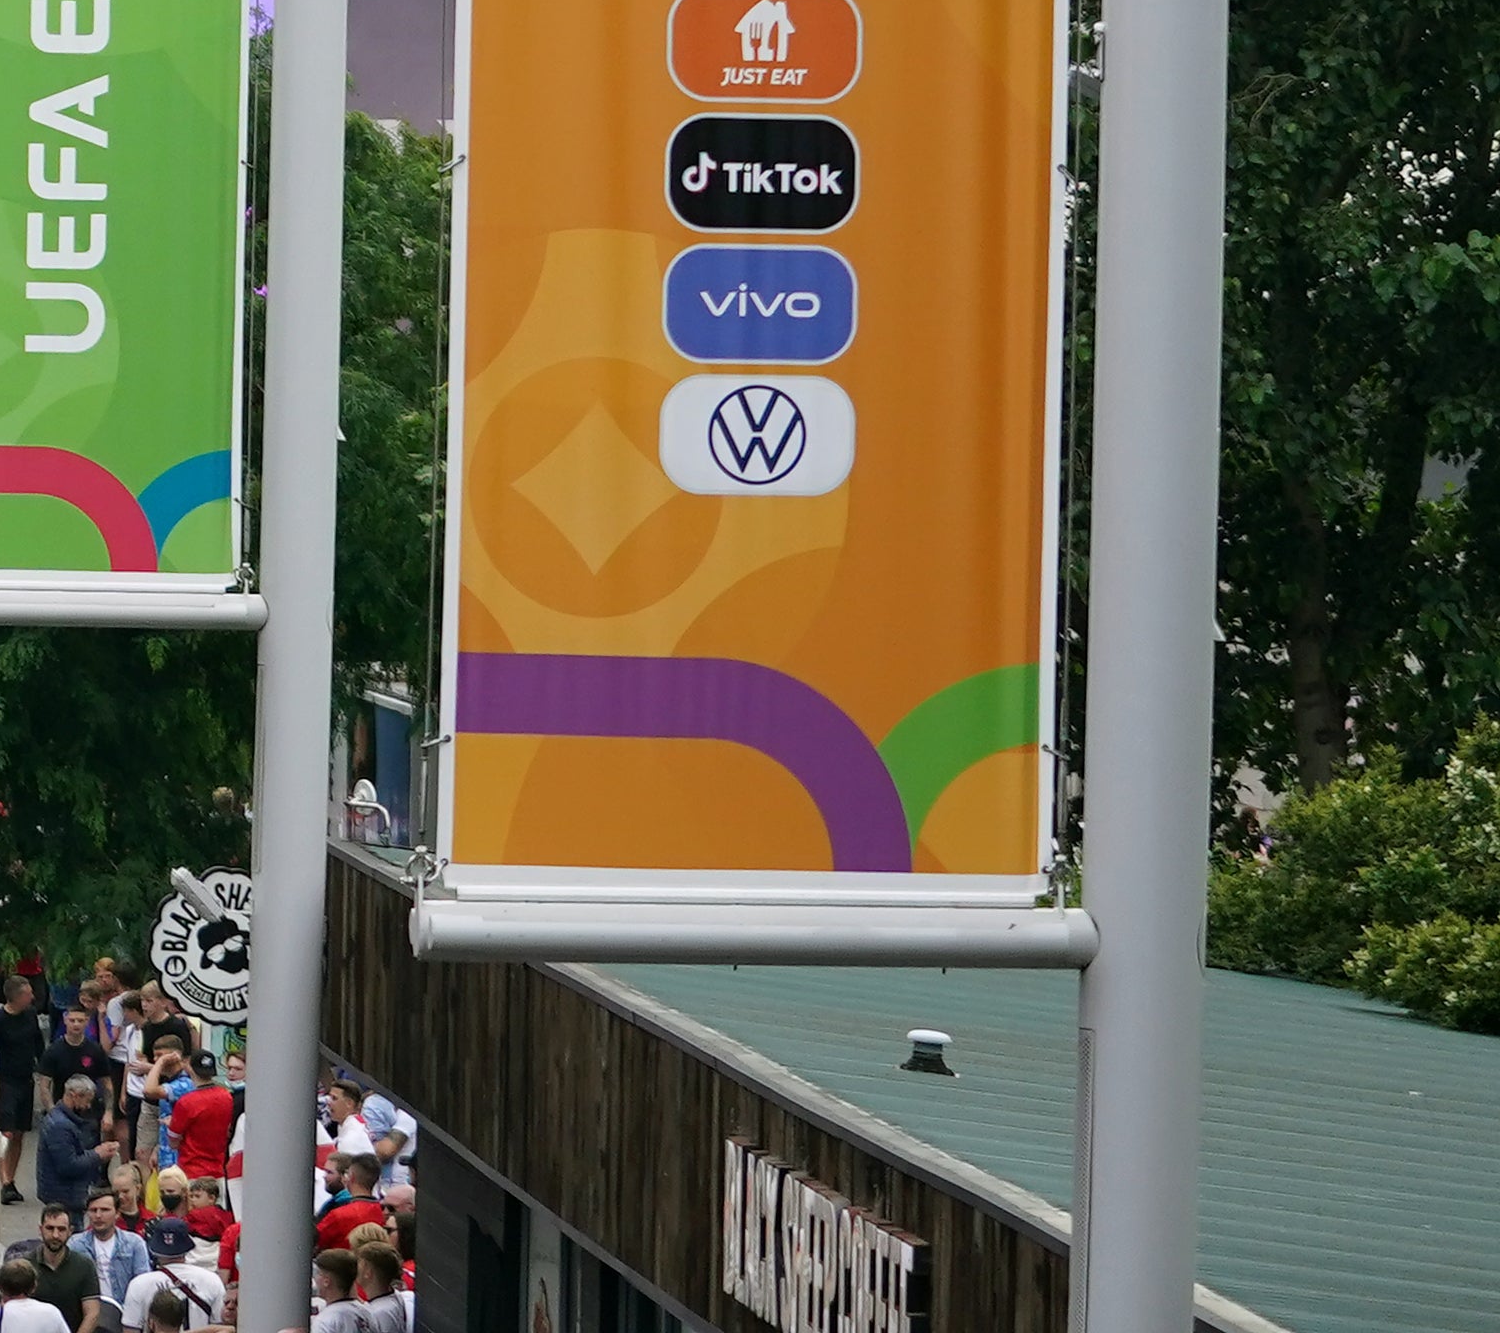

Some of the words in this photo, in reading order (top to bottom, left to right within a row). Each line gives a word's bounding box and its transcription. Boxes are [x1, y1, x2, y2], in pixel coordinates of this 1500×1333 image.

[720, 68, 767, 86] JUST
[771, 69, 808, 86] EAT
[723, 161, 843, 195] TikTok
[25, 74, 111, 354] UEFA
[700, 283, 820, 318] vivo
[161, 899, 202, 953] BLAC
